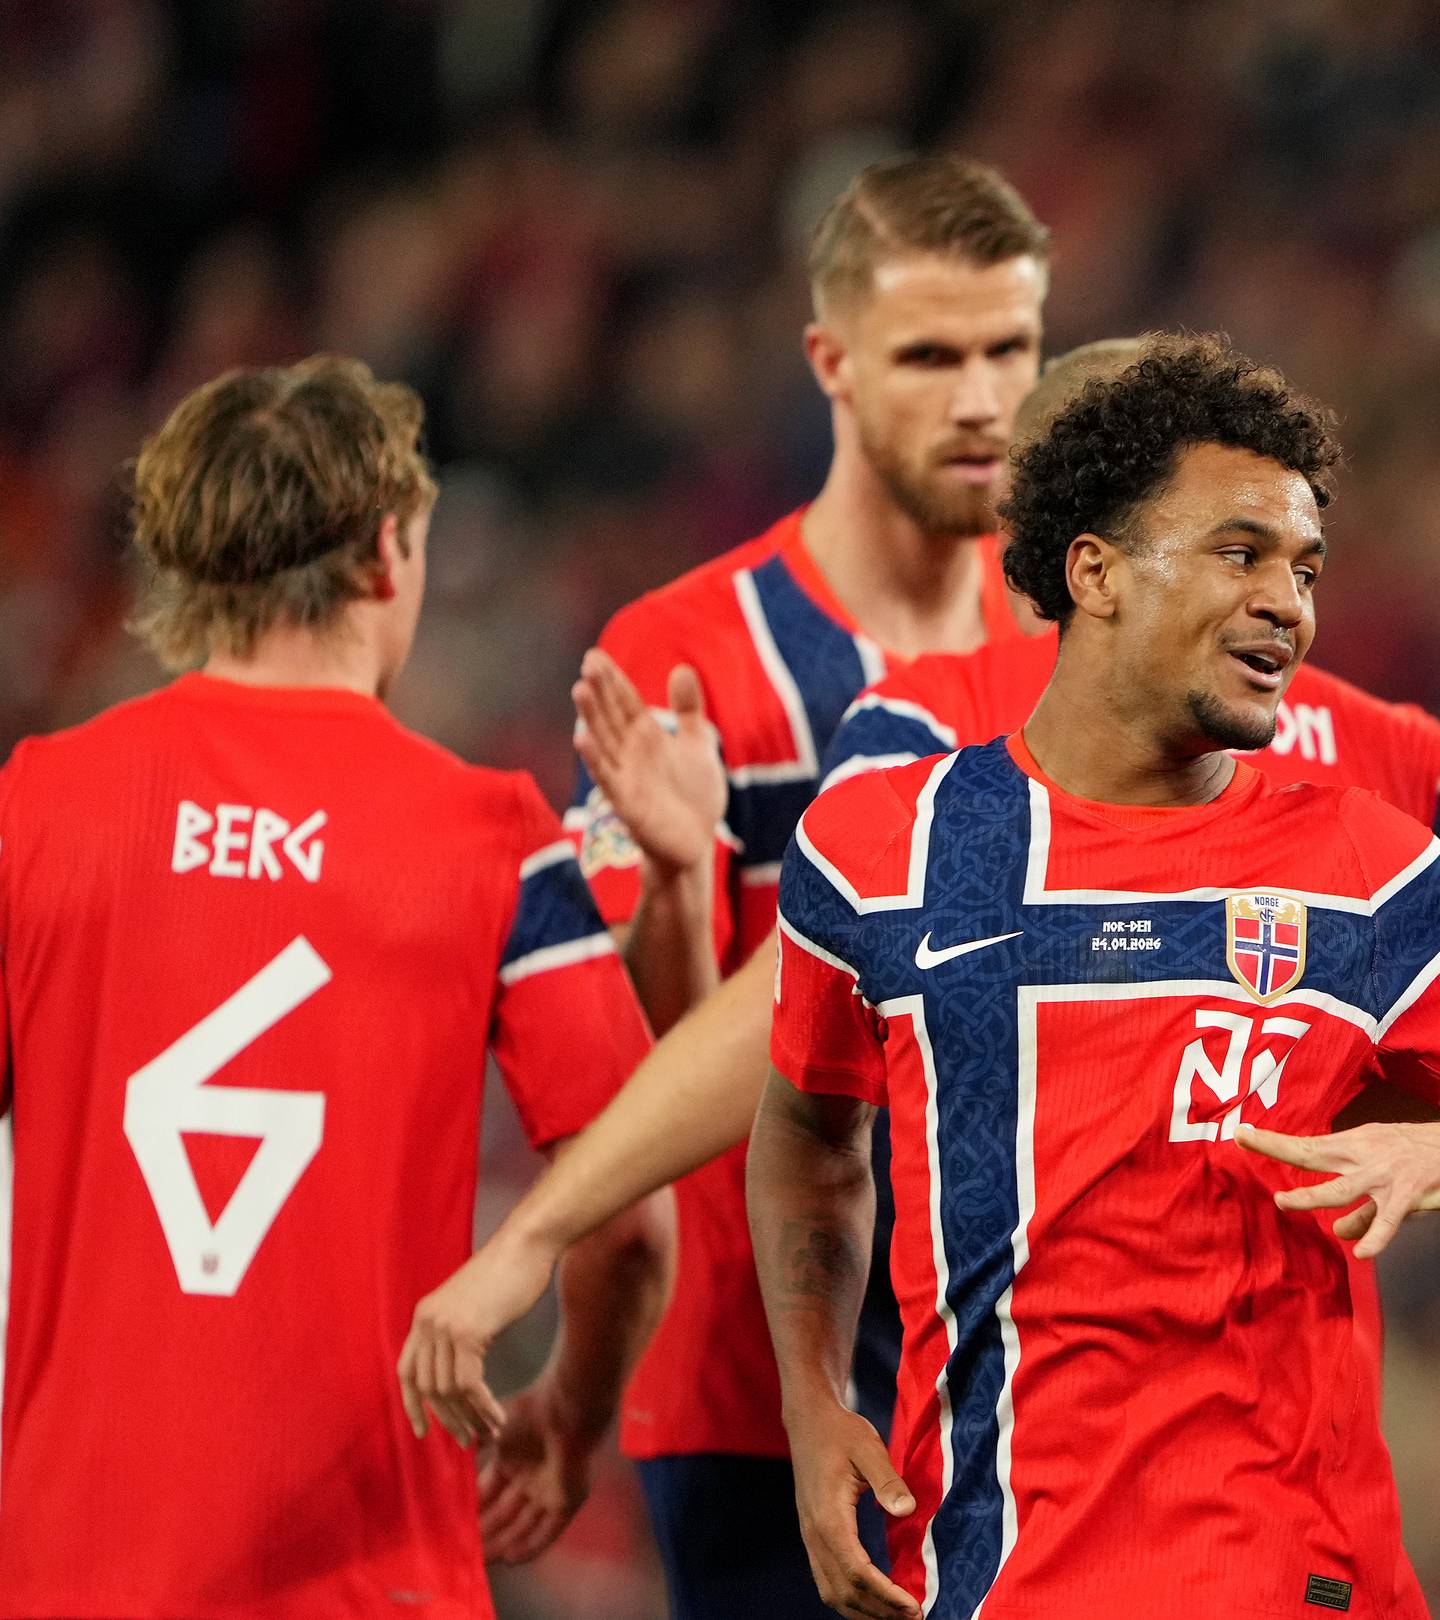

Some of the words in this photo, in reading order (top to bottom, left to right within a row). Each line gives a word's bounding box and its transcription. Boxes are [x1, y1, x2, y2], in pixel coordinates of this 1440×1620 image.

[171, 799, 328, 883] BERG
[1254, 896, 1279, 907] NORGE
[1102, 920, 1152, 933] NOR-DEN
[123, 935, 332, 1296] 6
